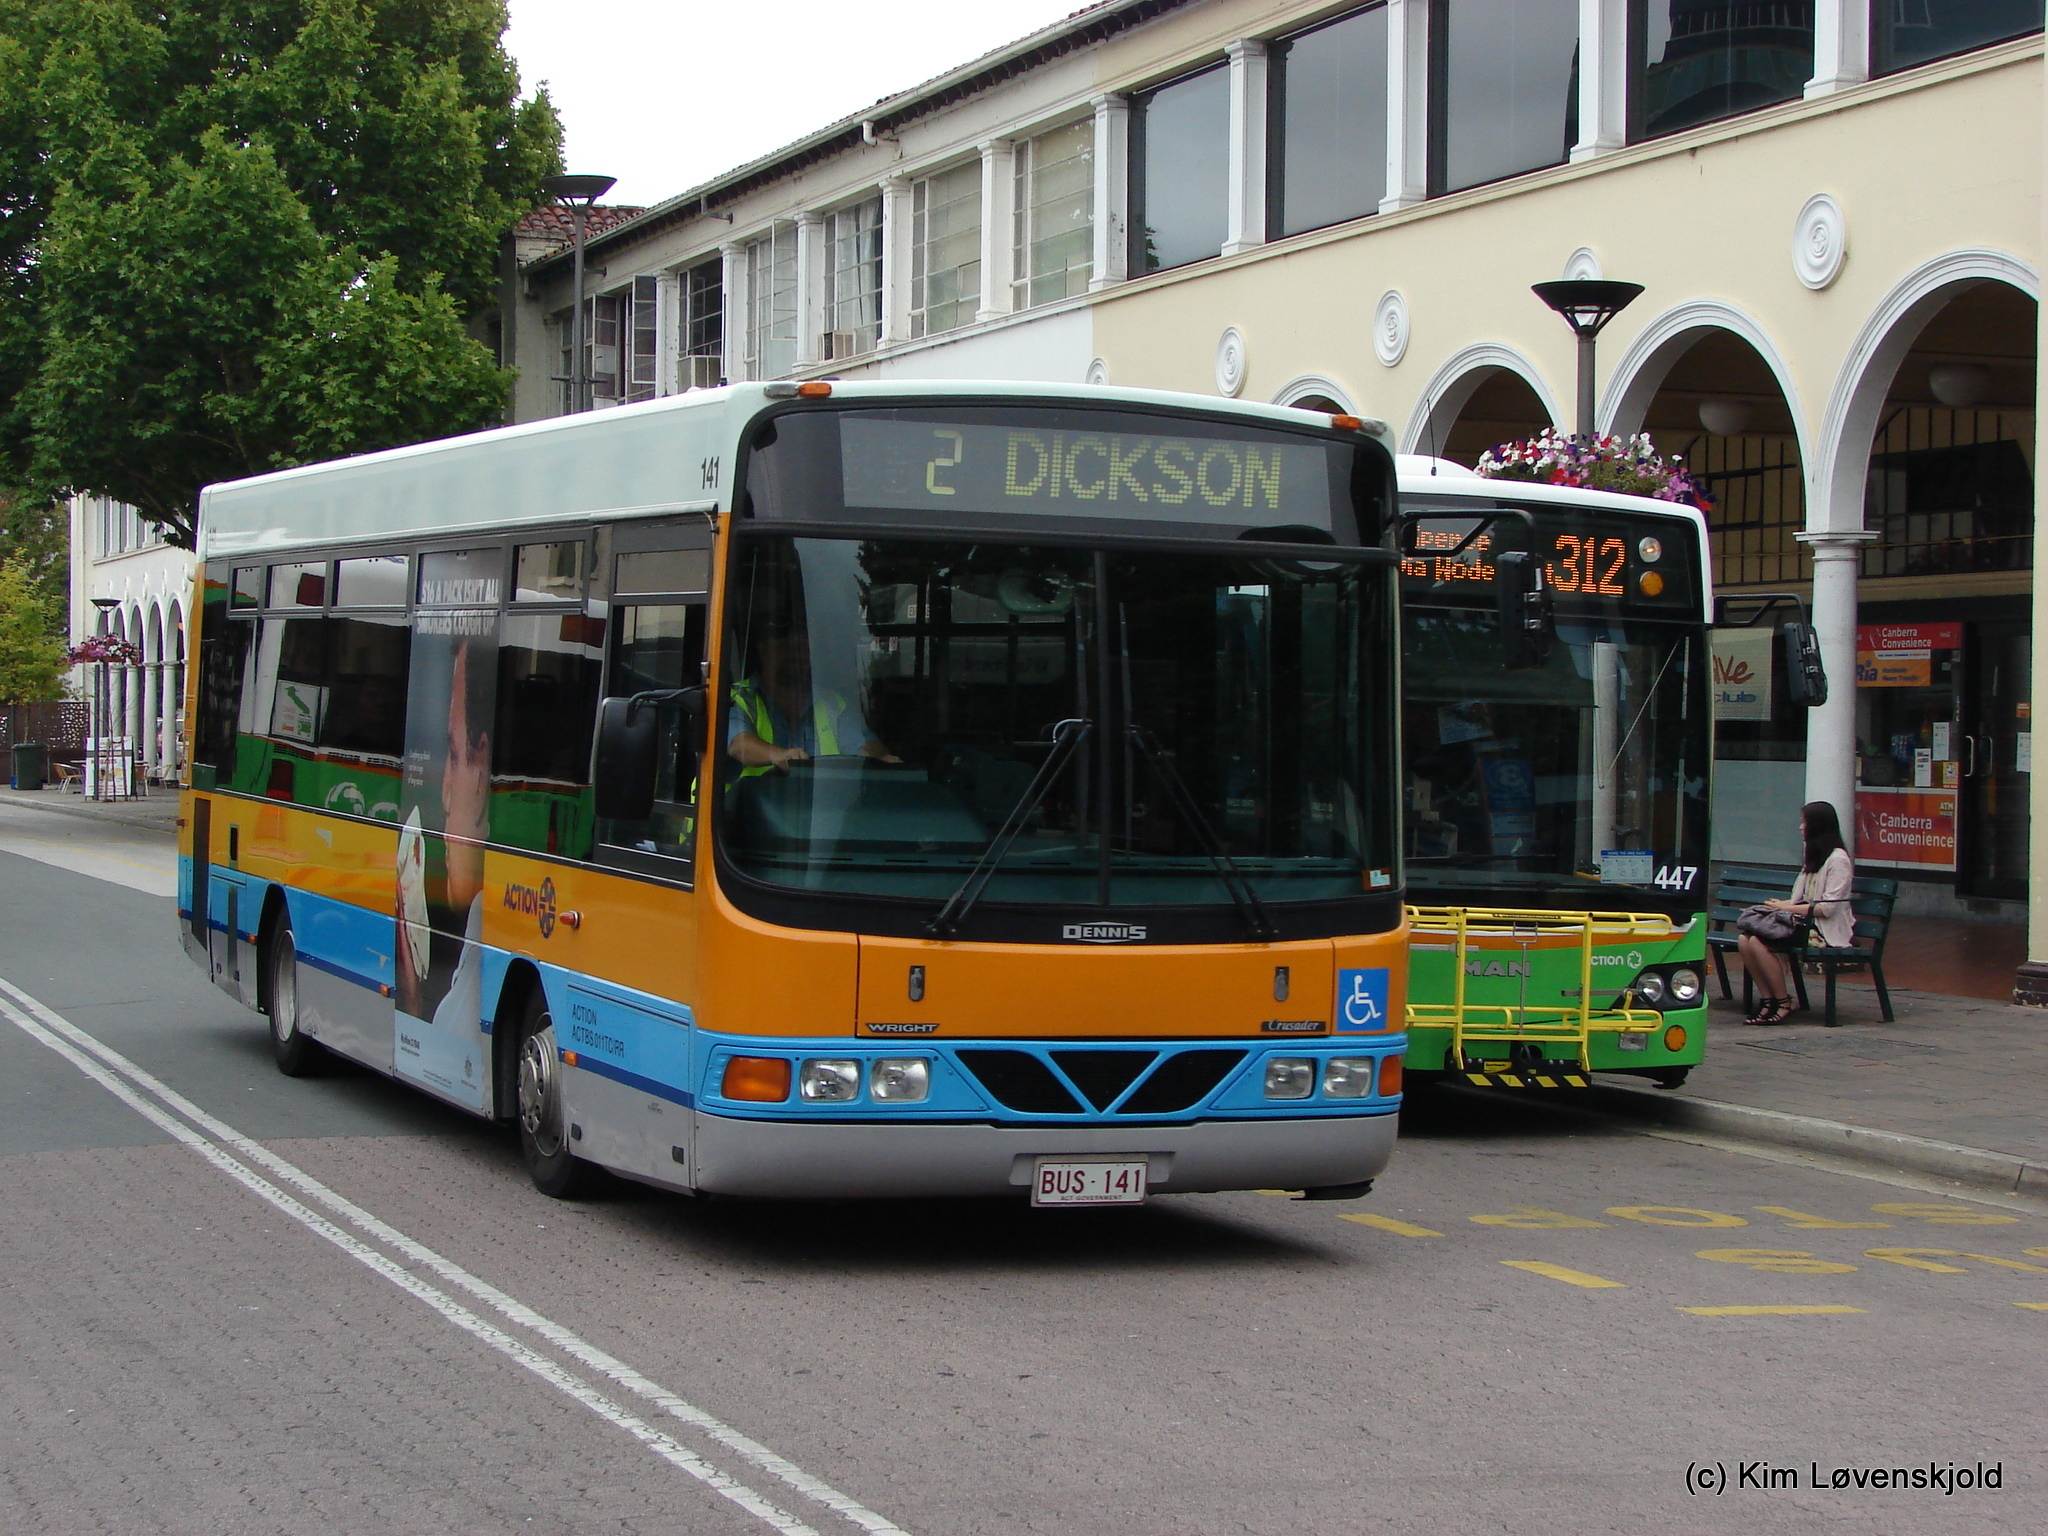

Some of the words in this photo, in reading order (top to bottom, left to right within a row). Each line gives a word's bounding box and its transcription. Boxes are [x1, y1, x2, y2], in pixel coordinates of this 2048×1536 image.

[701, 456, 720, 489] 141
[926, 429, 963, 495] 2
[1004, 430, 1282, 509] DICKSON
[1435, 556, 1495, 581] Wode
[1555, 534, 1626, 595] 312
[485, 578, 499, 604] ALL
[1882, 627, 1917, 638] Canberra
[1882, 638, 1932, 649] Convenience
[1939, 801, 1954, 811] ATM
[1879, 812, 1932, 830] Canberra
[1879, 829, 1954, 848] Convenience
[1654, 865, 1698, 890] 447
[504, 883, 539, 916] ACTION
[1063, 925, 1147, 940] DENNIS
[1465, 960, 1531, 978] MAN
[571, 1003, 598, 1026] ACTION
[1268, 1019, 1319, 1031] Crusader
[868, 1023, 938, 1033] WRIGHT
[1041, 1170, 1085, 1194] BUS
[1105, 1169, 1140, 1193] 141
